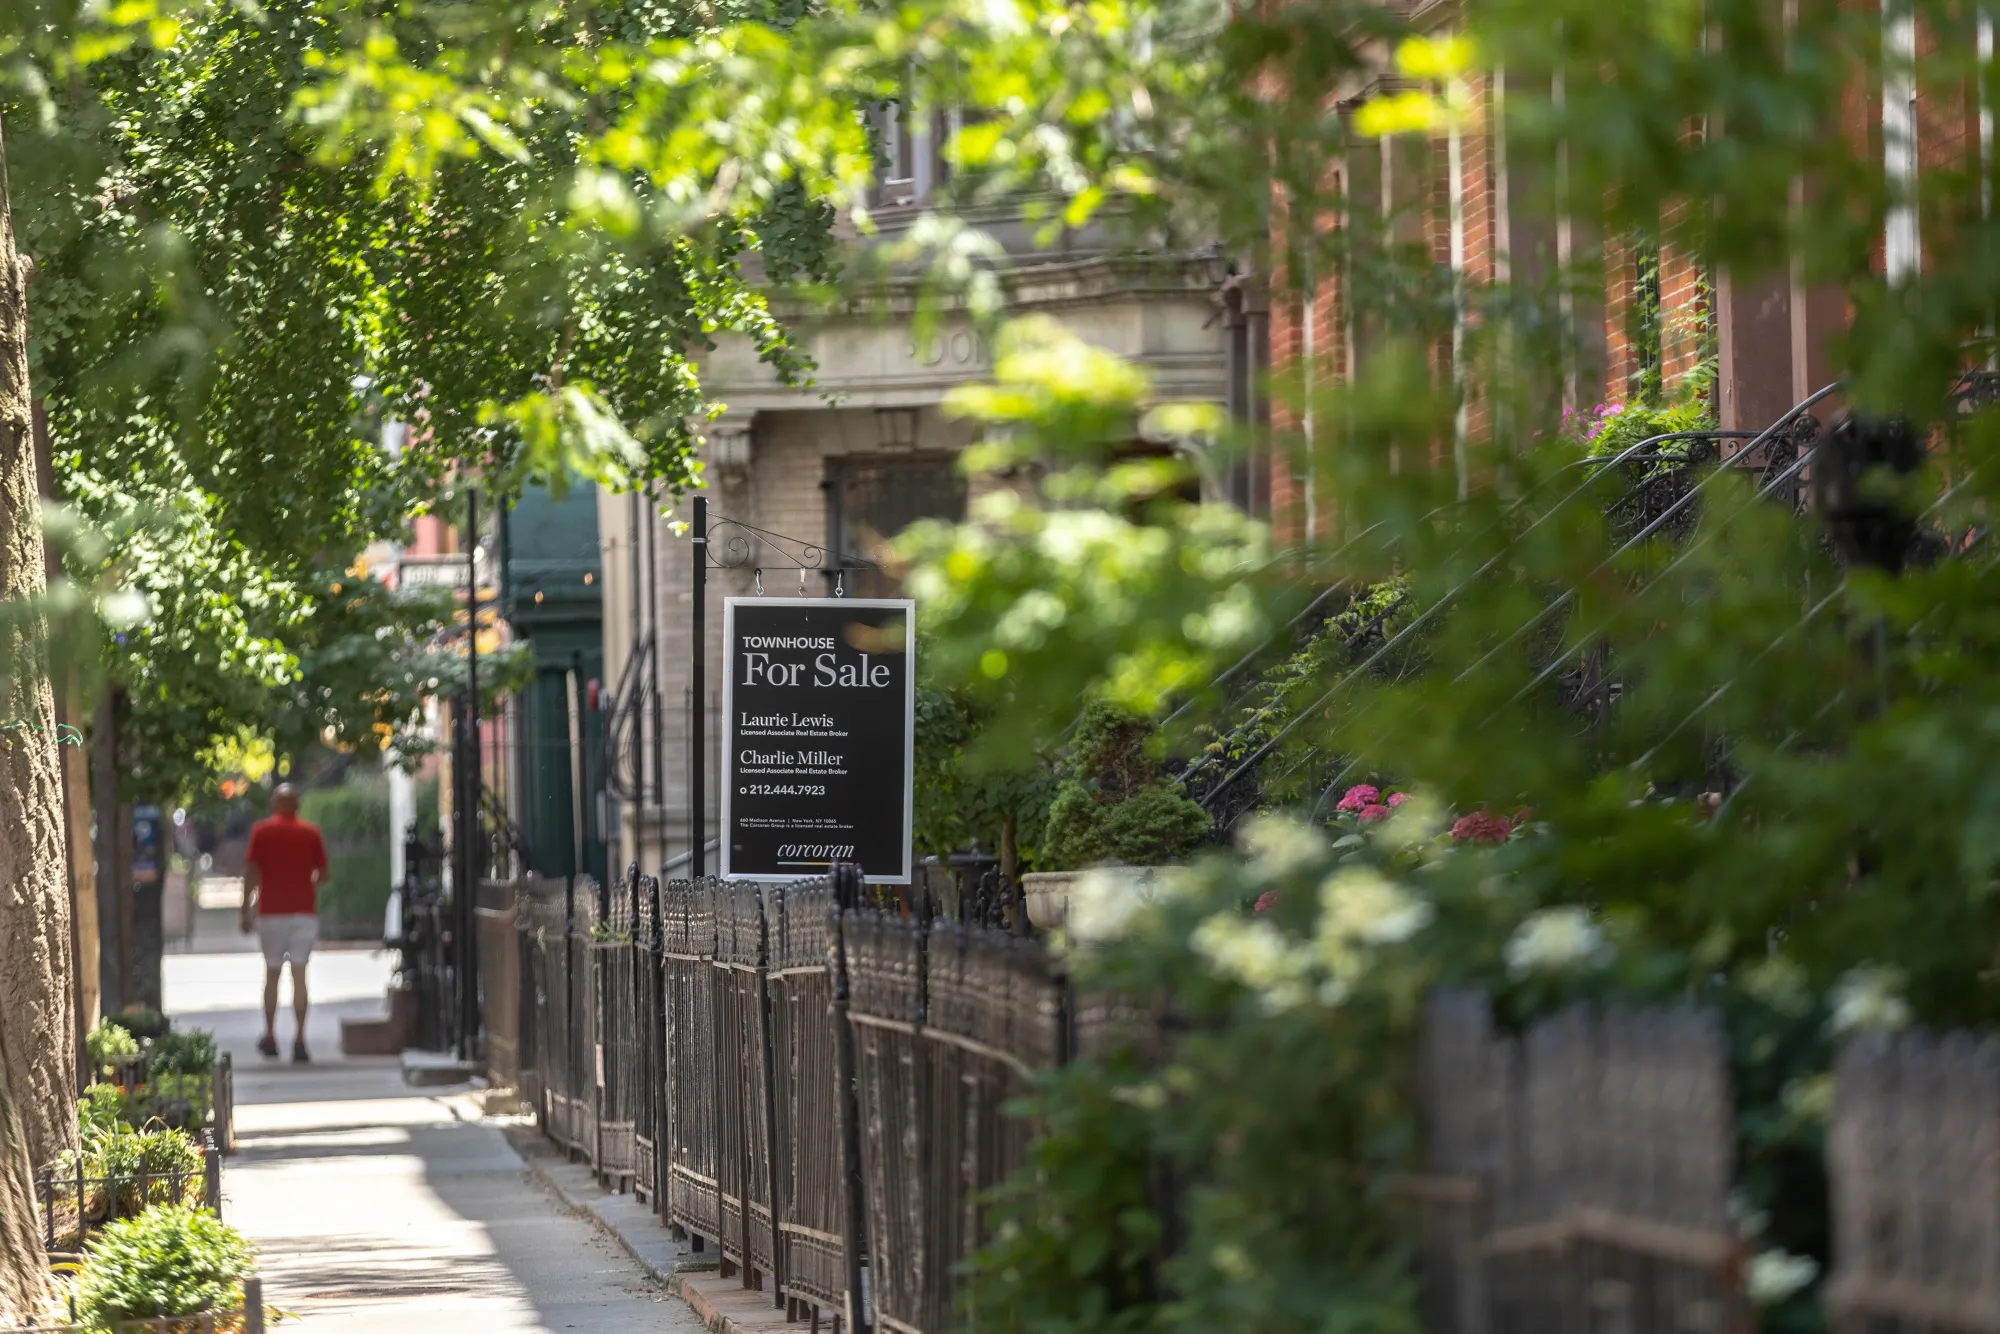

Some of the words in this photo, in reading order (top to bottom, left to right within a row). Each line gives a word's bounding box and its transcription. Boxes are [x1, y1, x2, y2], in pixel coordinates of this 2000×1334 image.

[742, 636, 835, 649] TOWNHOUSE
[742, 652, 806, 687] For
[814, 652, 890, 688] Sale
[740, 712, 789, 727] Laurie
[791, 712, 834, 728] Lewis
[767, 729, 795, 737] Associate
[740, 750, 794, 765] Charlie
[796, 751, 843, 766] Miller
[766, 767, 794, 775] Associate
[749, 784, 826, 796] 212.444.7923
[777, 843, 855, 858] corcoran
